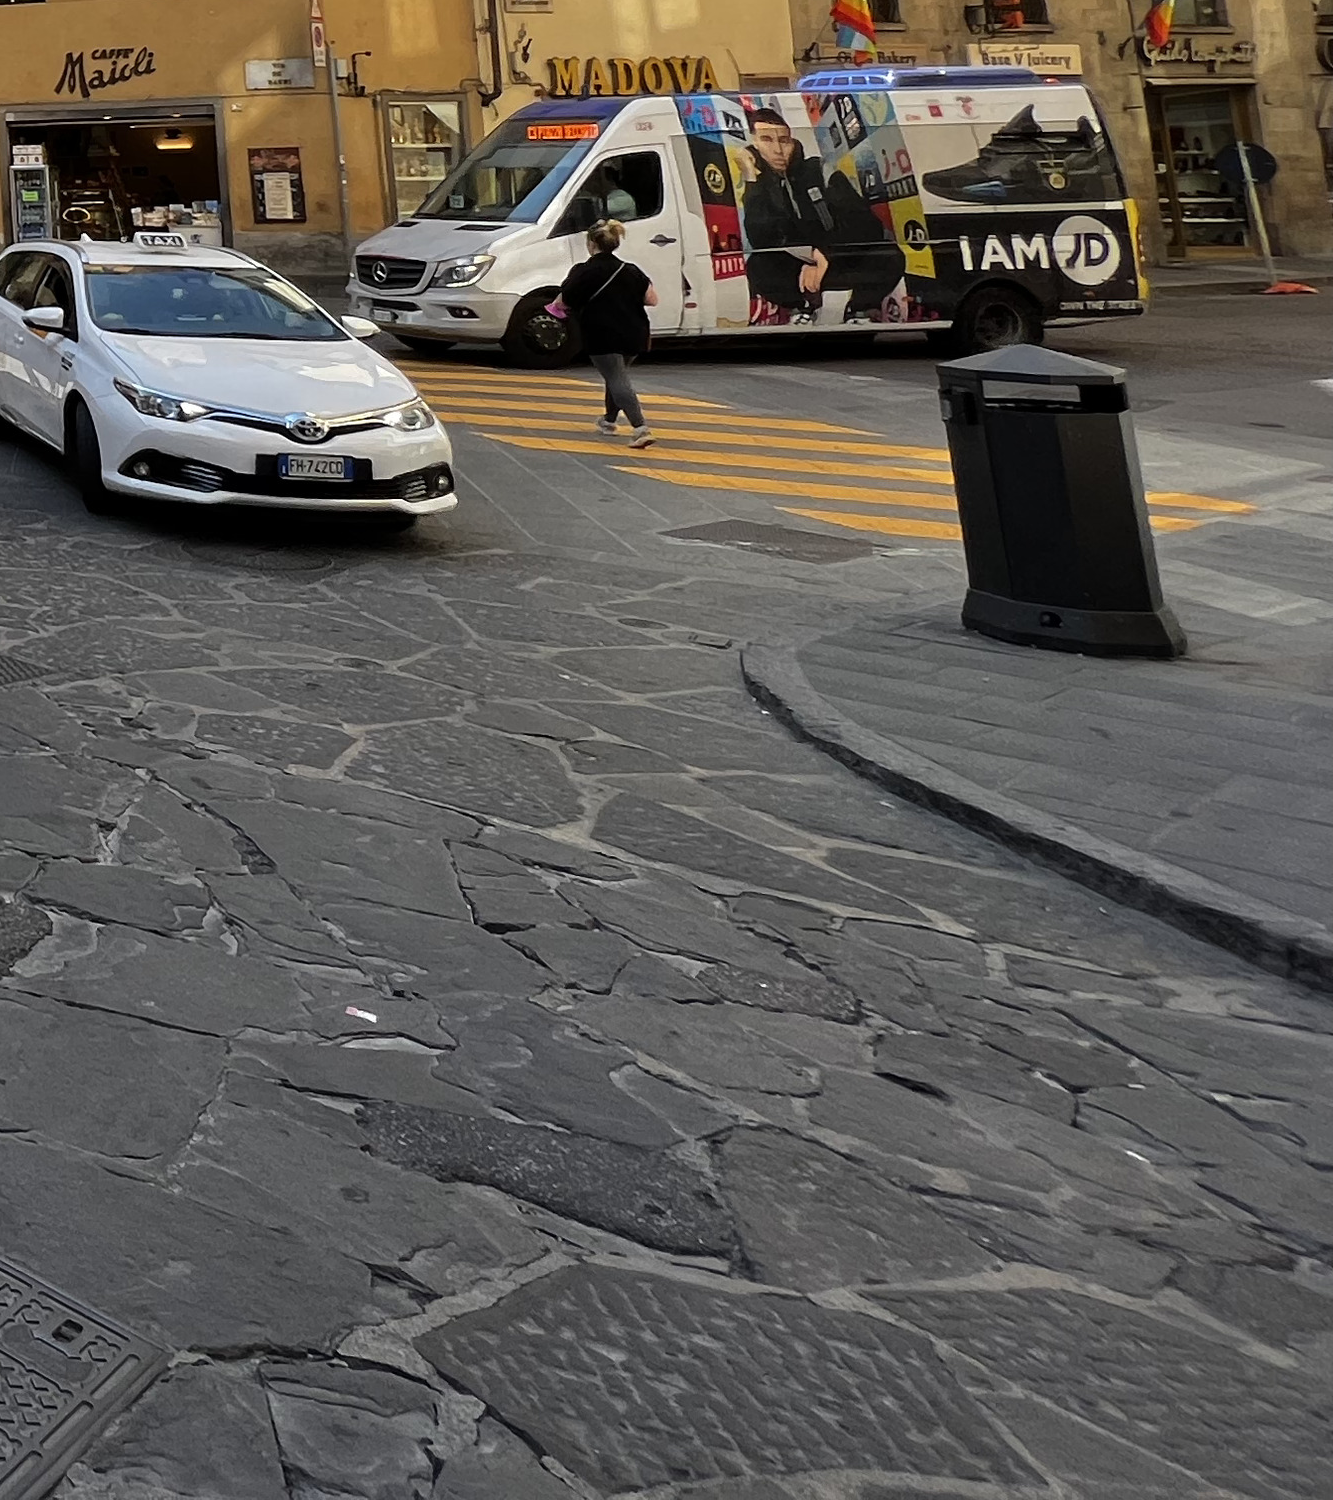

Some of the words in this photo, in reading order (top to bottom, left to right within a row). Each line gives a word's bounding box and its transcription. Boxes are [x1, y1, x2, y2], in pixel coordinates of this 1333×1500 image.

[54, 46, 156, 98] Maioli
[548, 56, 721, 97] MADOVA
[876, 50, 917, 66] Bakery
[141, 236, 182, 246] TAXI
[980, 233, 1051, 271] AM
[1065, 232, 1110, 269] JD
